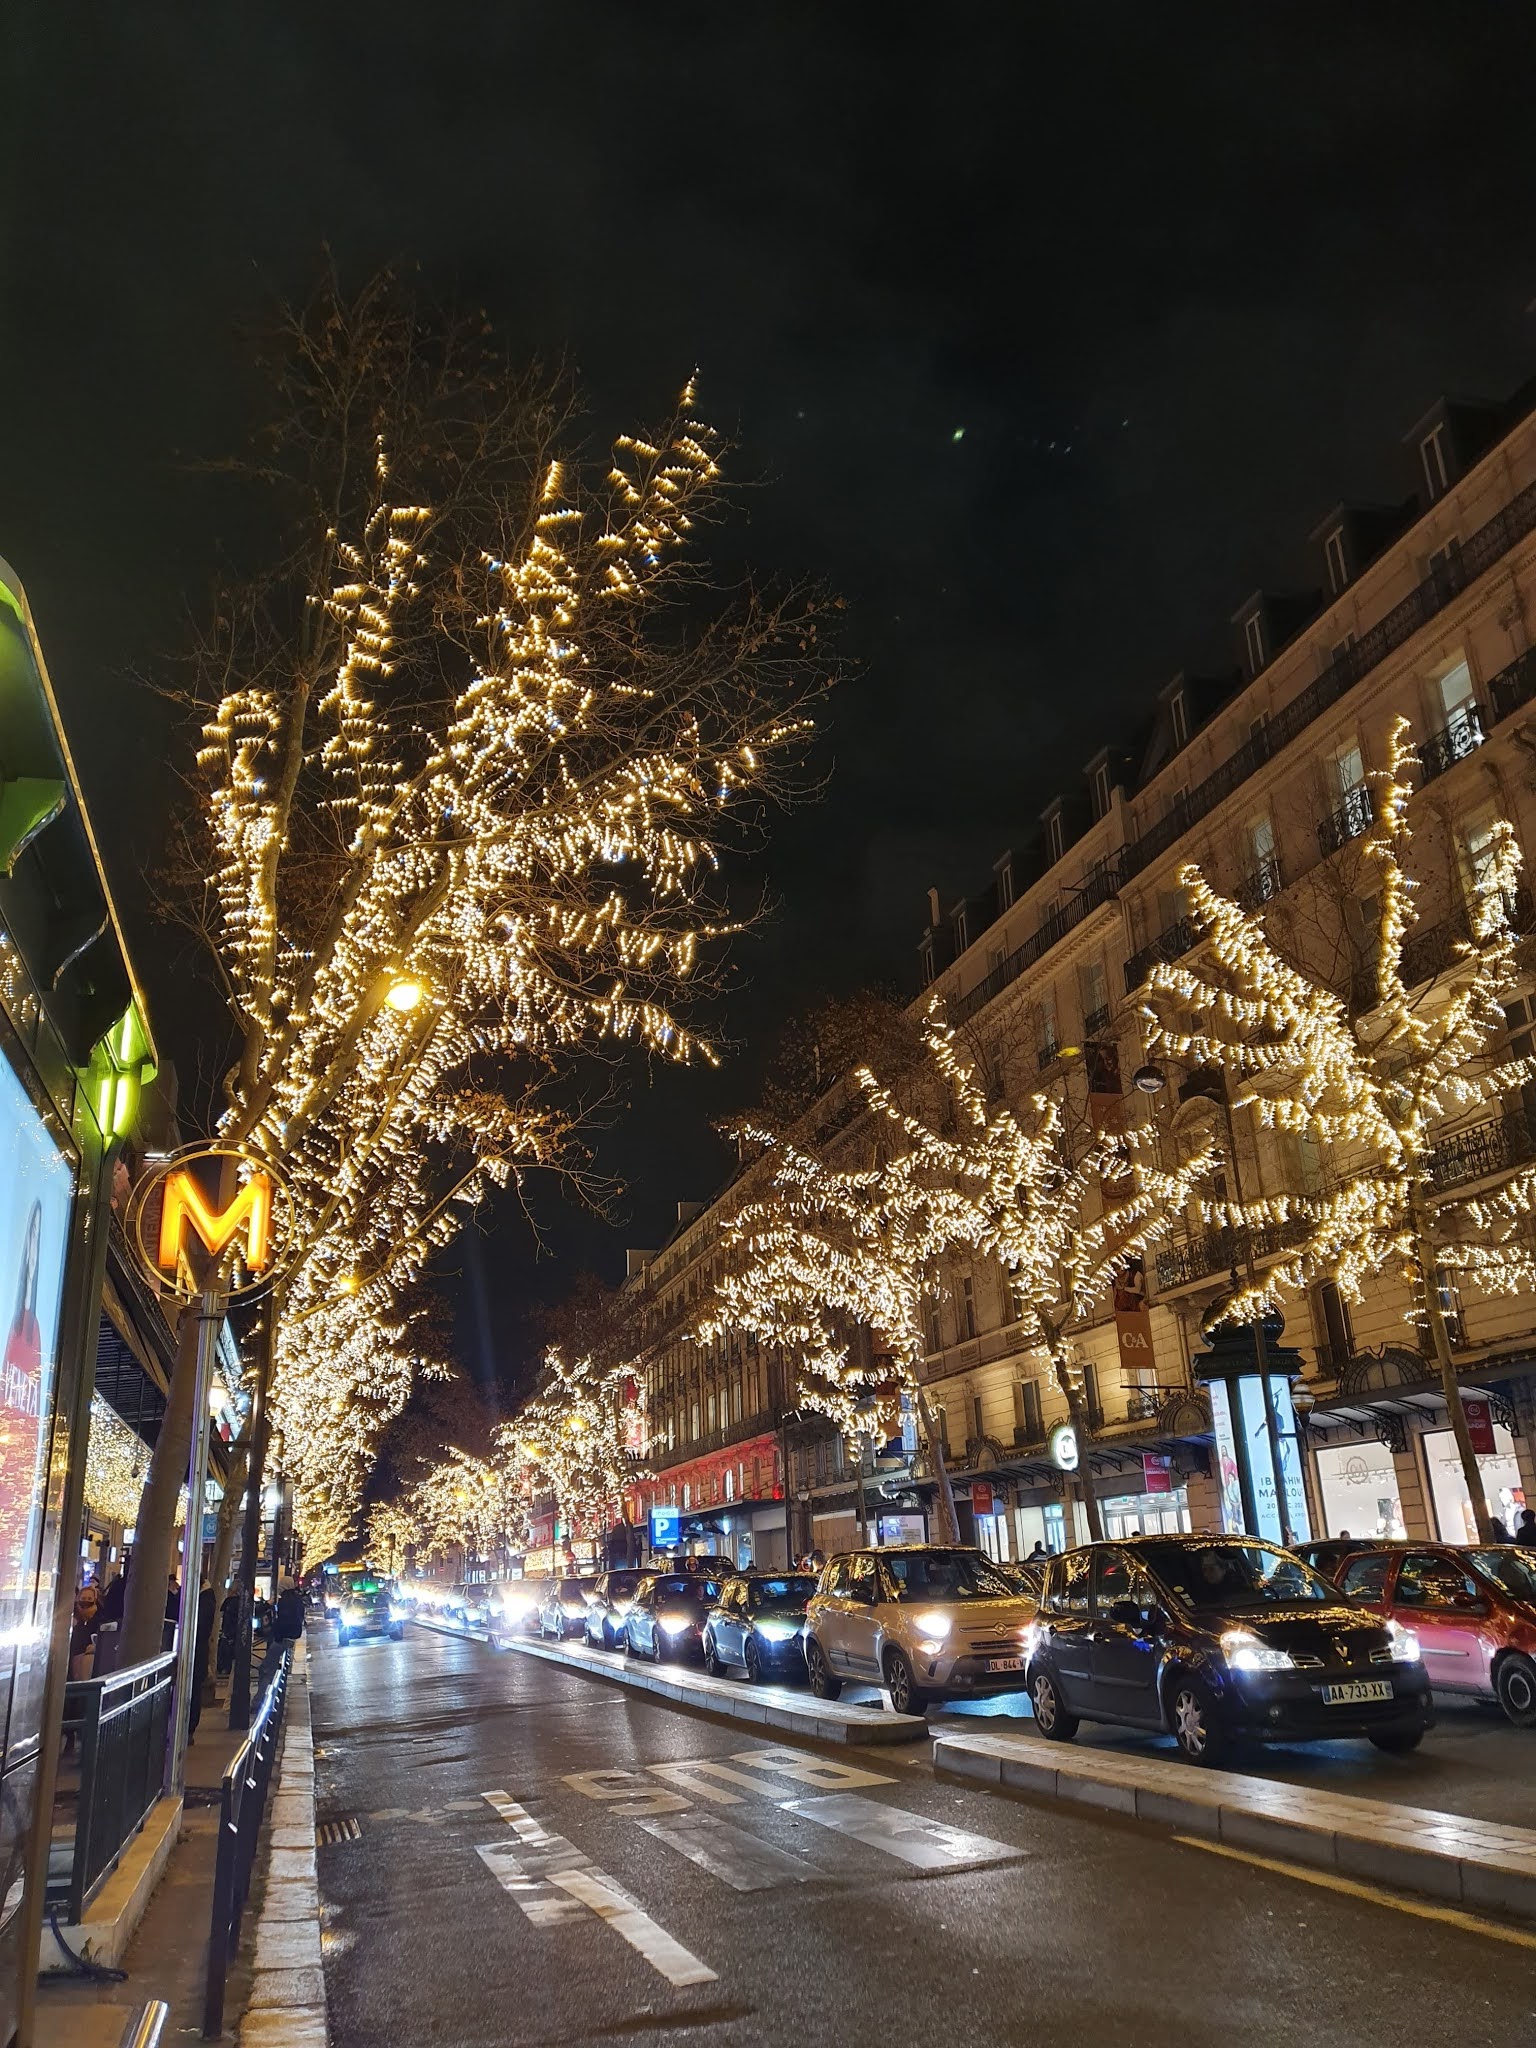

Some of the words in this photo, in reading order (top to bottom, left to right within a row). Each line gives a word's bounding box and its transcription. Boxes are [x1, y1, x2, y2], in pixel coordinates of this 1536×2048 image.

[158, 1172, 272, 1272] M
[1121, 1332, 1149, 1348] C&A
[655, 1518, 670, 1538] P
[1331, 1682, 1385, 1701] AA-733-XX
[561, 1747, 901, 1816] BUS
